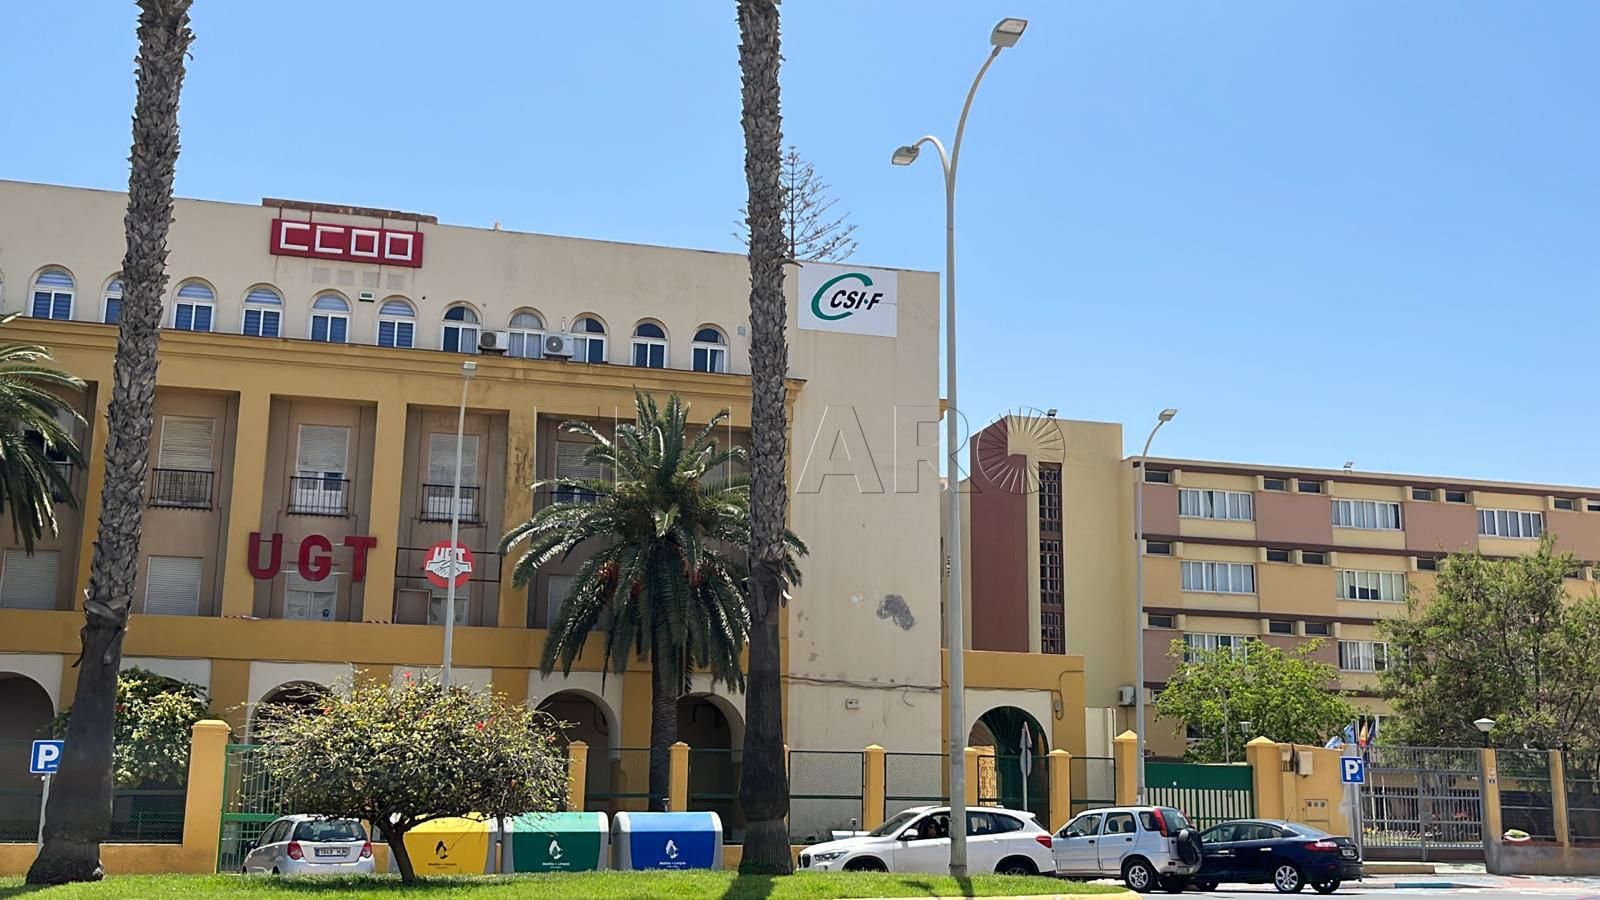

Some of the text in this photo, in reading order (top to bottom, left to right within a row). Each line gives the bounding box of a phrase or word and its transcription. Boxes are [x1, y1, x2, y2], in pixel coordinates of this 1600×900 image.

[279, 221, 414, 261] CCOO
[247, 531, 378, 584] UGT
[37, 744, 60, 769] P
[1345, 759, 1359, 780] P
